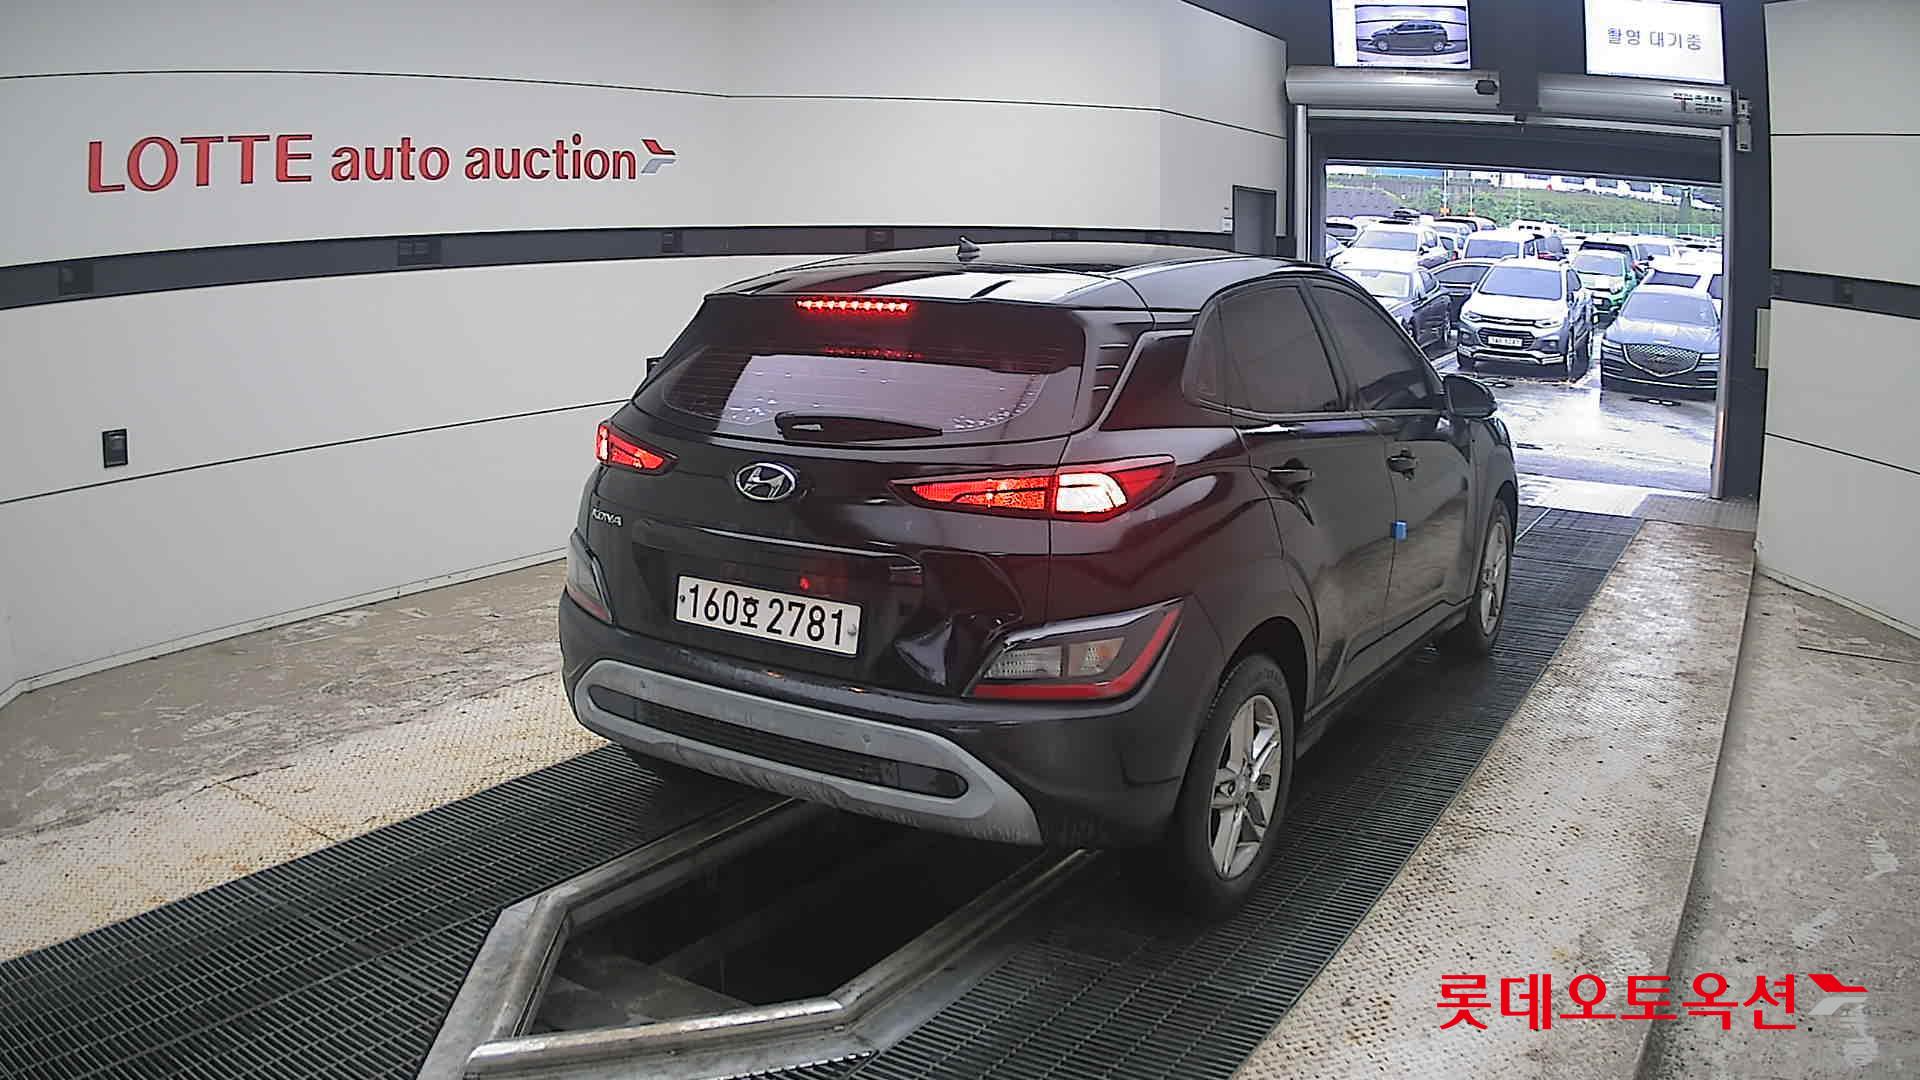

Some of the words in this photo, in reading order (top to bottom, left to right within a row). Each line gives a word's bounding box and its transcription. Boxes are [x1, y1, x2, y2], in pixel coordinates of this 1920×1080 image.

[1649, 31, 1702, 51] 대기중
[87, 133, 313, 193] LOTTE
[330, 137, 450, 181] auto
[464, 132, 637, 180] auction
[689, 583, 760, 629] 160호
[766, 597, 844, 646] 2781
